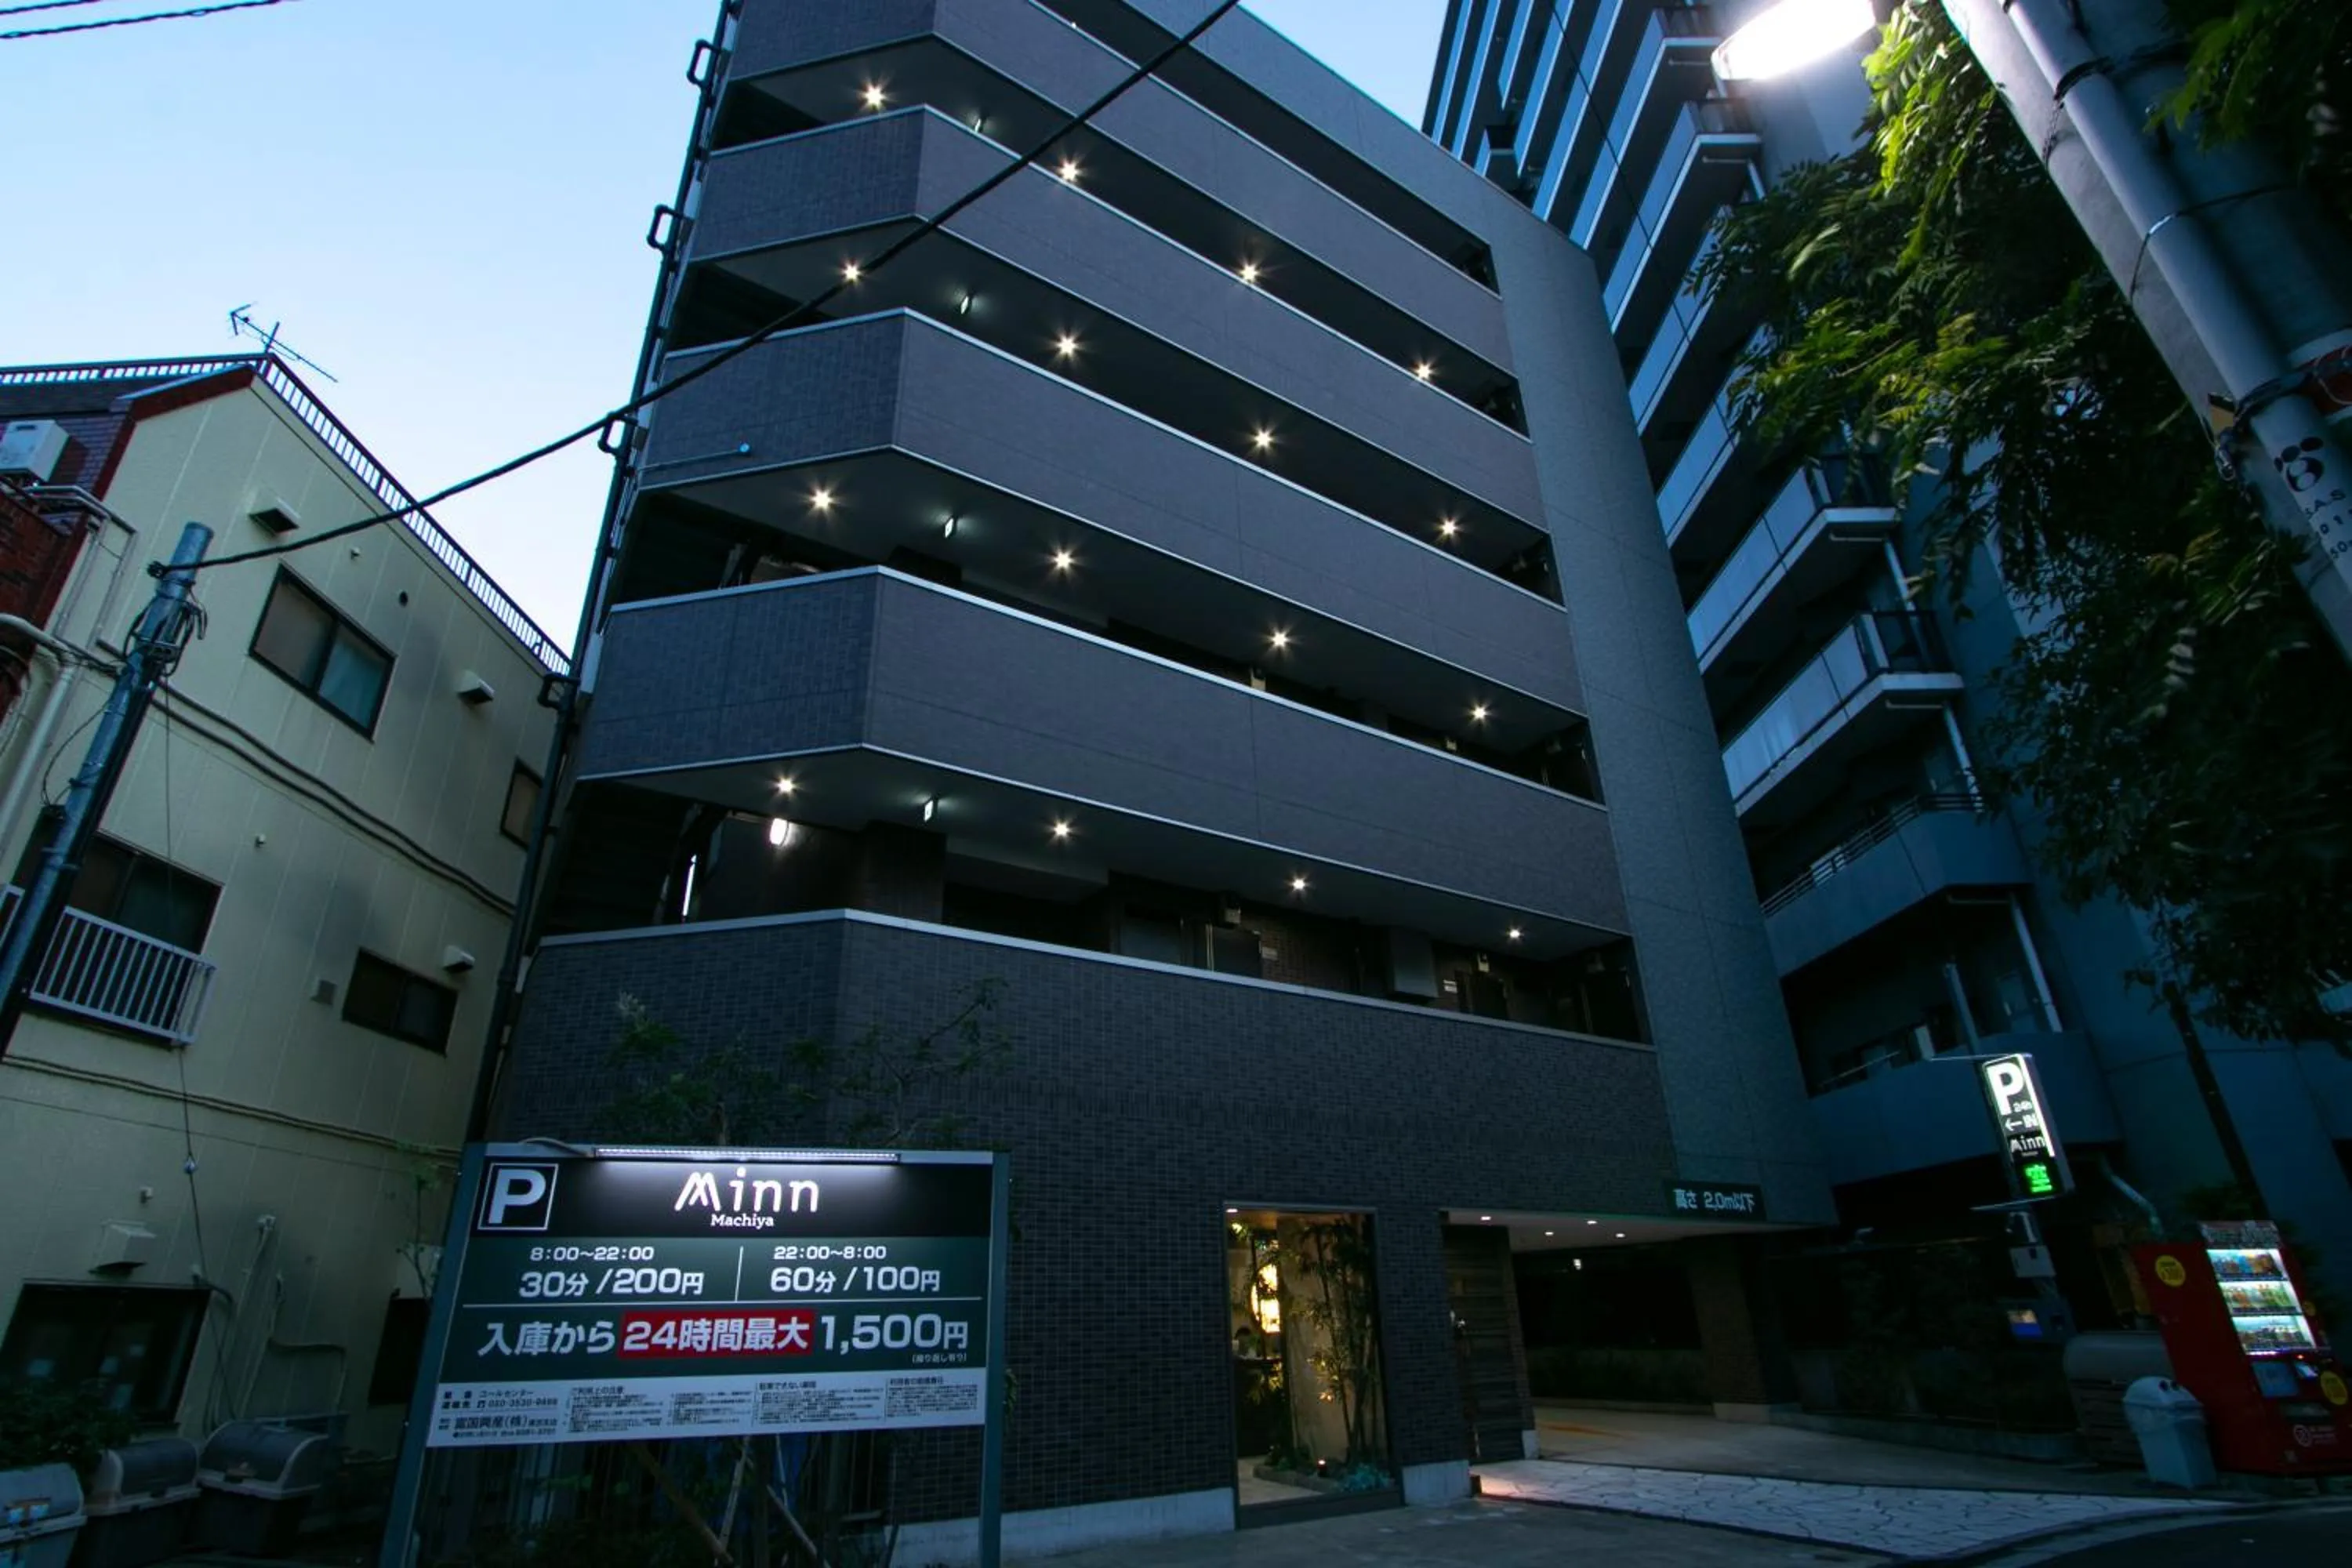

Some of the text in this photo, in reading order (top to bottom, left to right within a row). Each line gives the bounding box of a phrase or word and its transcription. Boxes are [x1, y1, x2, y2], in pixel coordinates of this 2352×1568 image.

[1987, 1062, 2024, 1116] P
[488, 1168, 546, 1224] P
[674, 1167, 820, 1212] Minn
[710, 1214, 774, 1229] Machiya
[477, 1314, 968, 1356] 入庫から 24時間最大 1,500円
